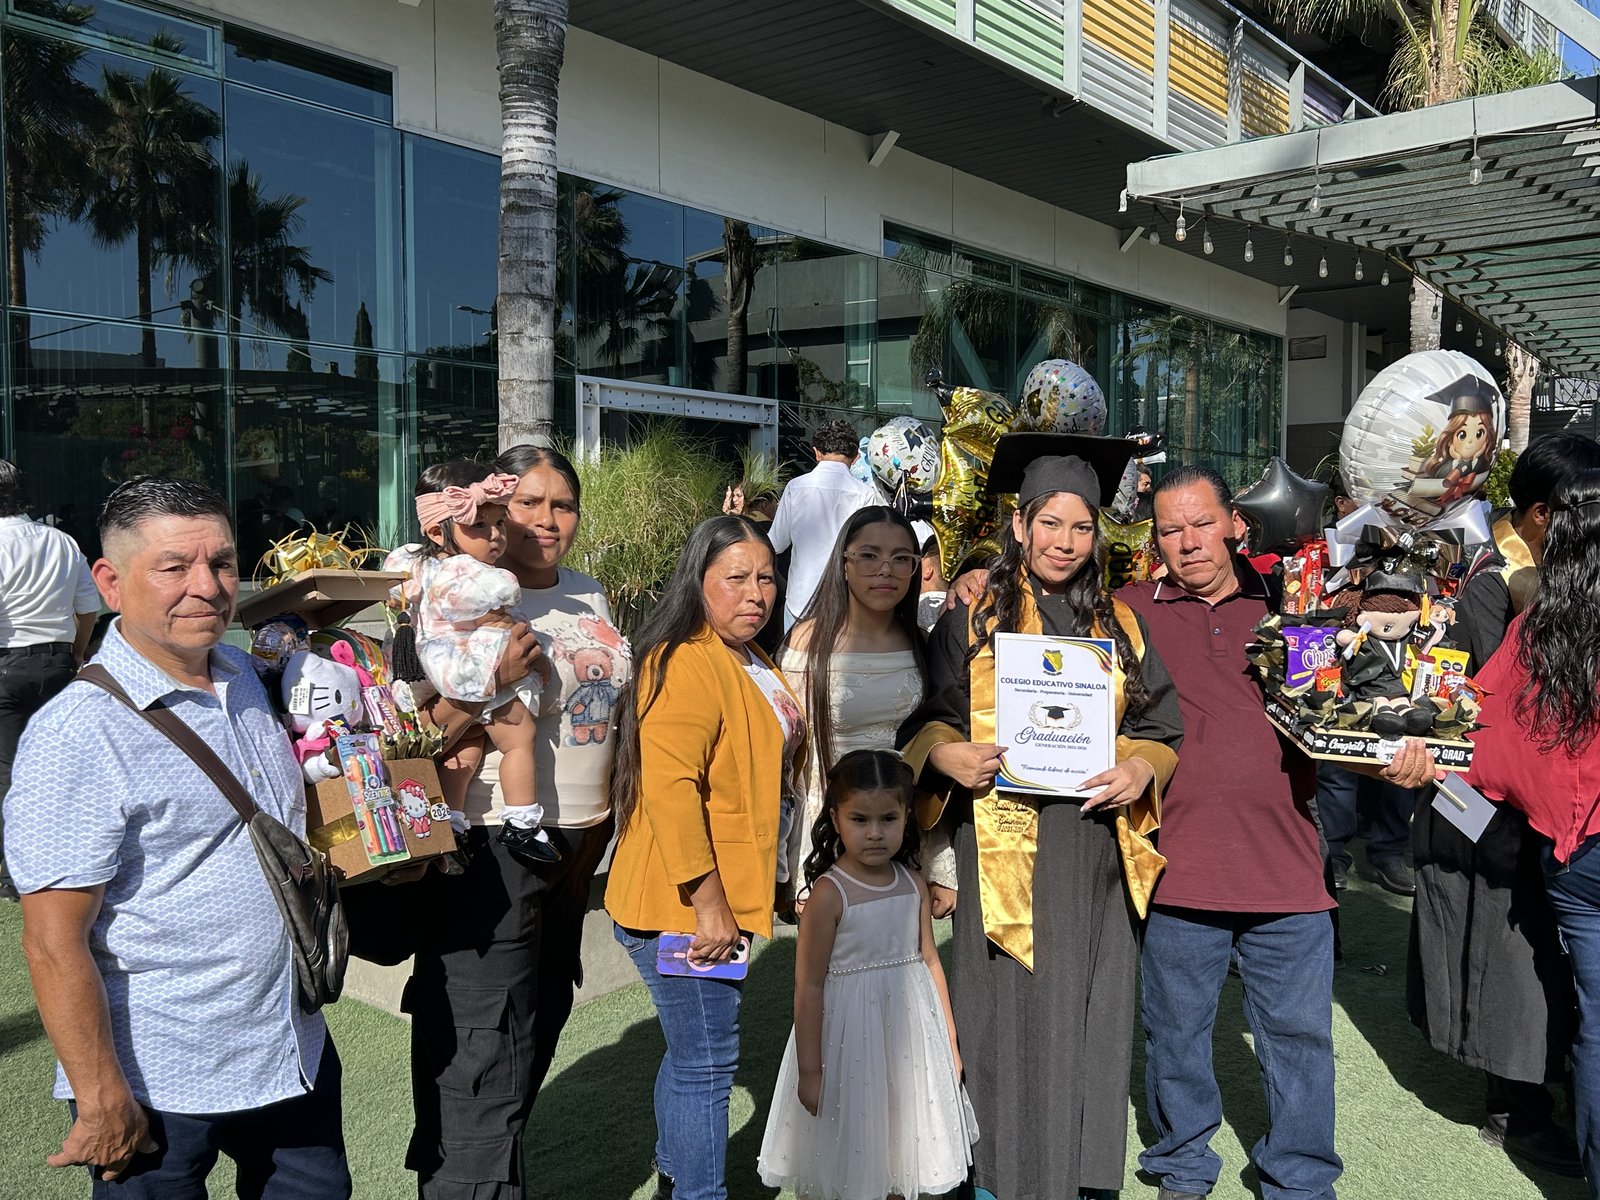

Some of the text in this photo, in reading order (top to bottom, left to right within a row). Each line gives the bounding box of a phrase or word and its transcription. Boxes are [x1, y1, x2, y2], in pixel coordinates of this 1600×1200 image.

[985, 400, 1012, 425] GR
[1000, 677, 1107, 690] COLEGIO EDUCATIVO SINALOA
[1014, 726, 1092, 744] Graduación
[1328, 737, 1365, 754] Congrats
[1366, 742, 1378, 753] GR
[1442, 748, 1465, 761] GRAD
[432, 807, 451, 819] 2026
